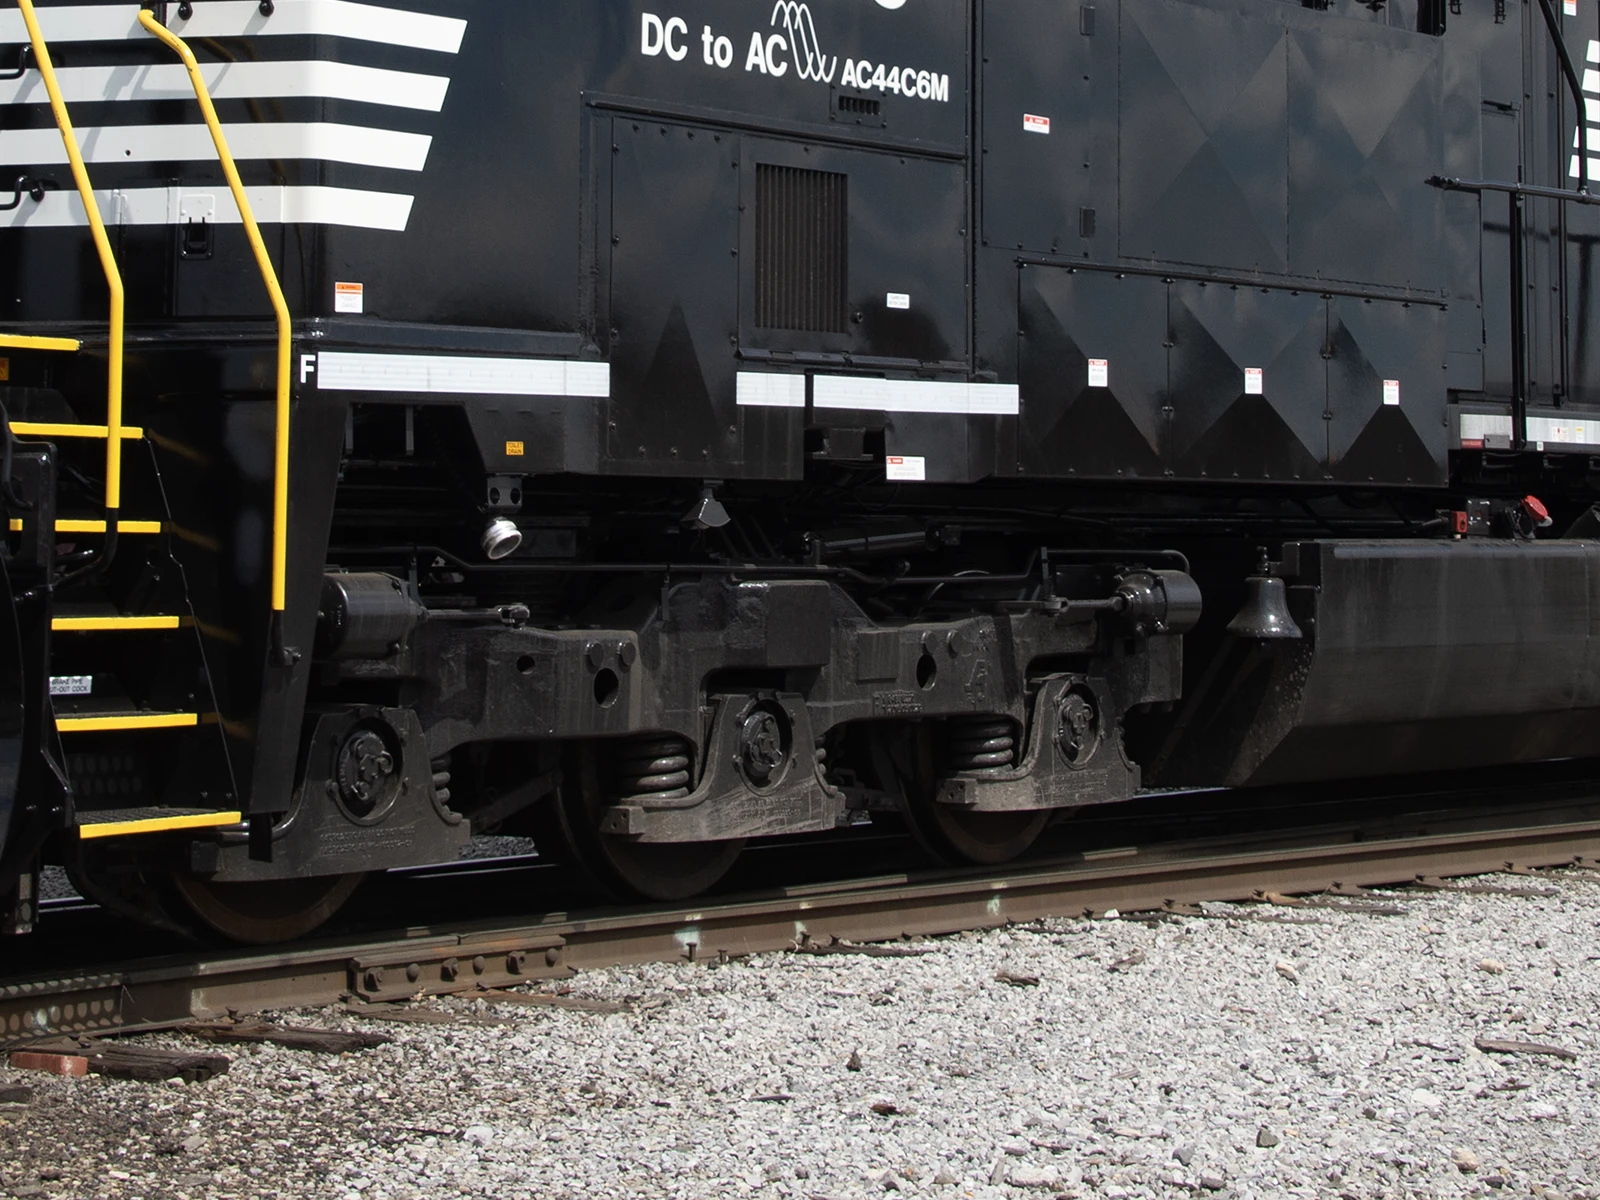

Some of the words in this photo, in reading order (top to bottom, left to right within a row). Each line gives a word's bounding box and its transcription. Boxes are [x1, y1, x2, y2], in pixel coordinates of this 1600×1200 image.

[641, 12, 688, 61] DC
[701, 25, 733, 68] to
[745, 31, 788, 77] AC
[841, 58, 949, 102] AC44C6M
[300, 354, 316, 383] F
[51, 678, 69, 686] BRAKE
